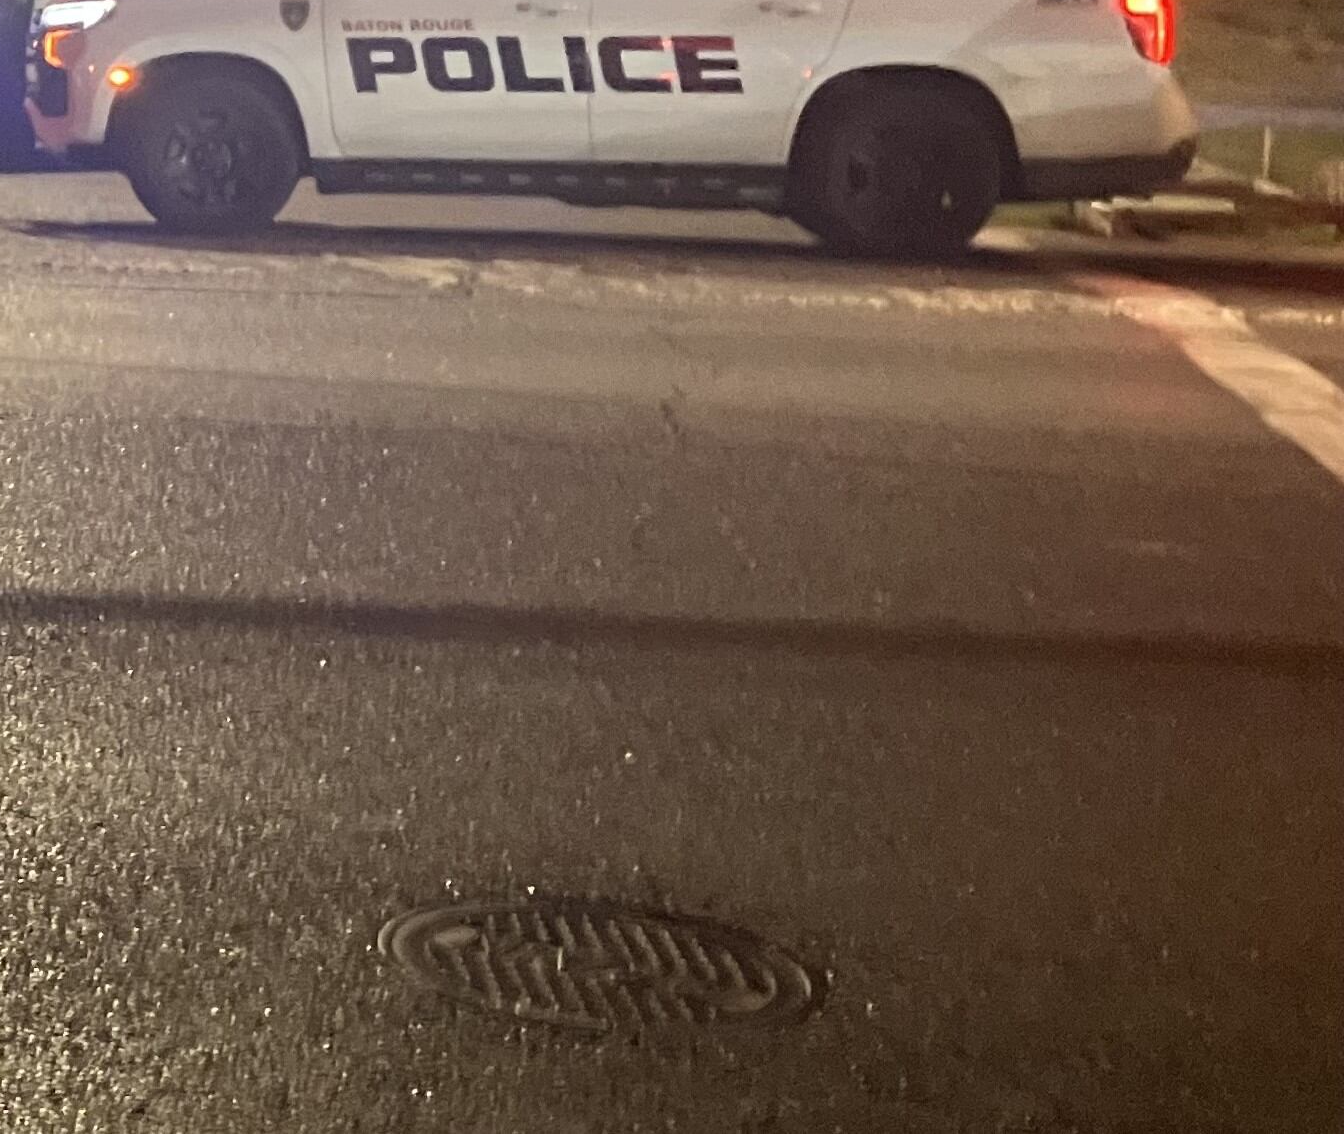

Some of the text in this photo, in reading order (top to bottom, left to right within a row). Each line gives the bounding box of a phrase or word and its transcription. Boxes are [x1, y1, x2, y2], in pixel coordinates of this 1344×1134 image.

[341, 18, 476, 33] BATON ROUGE
[345, 35, 744, 94] POLICE
